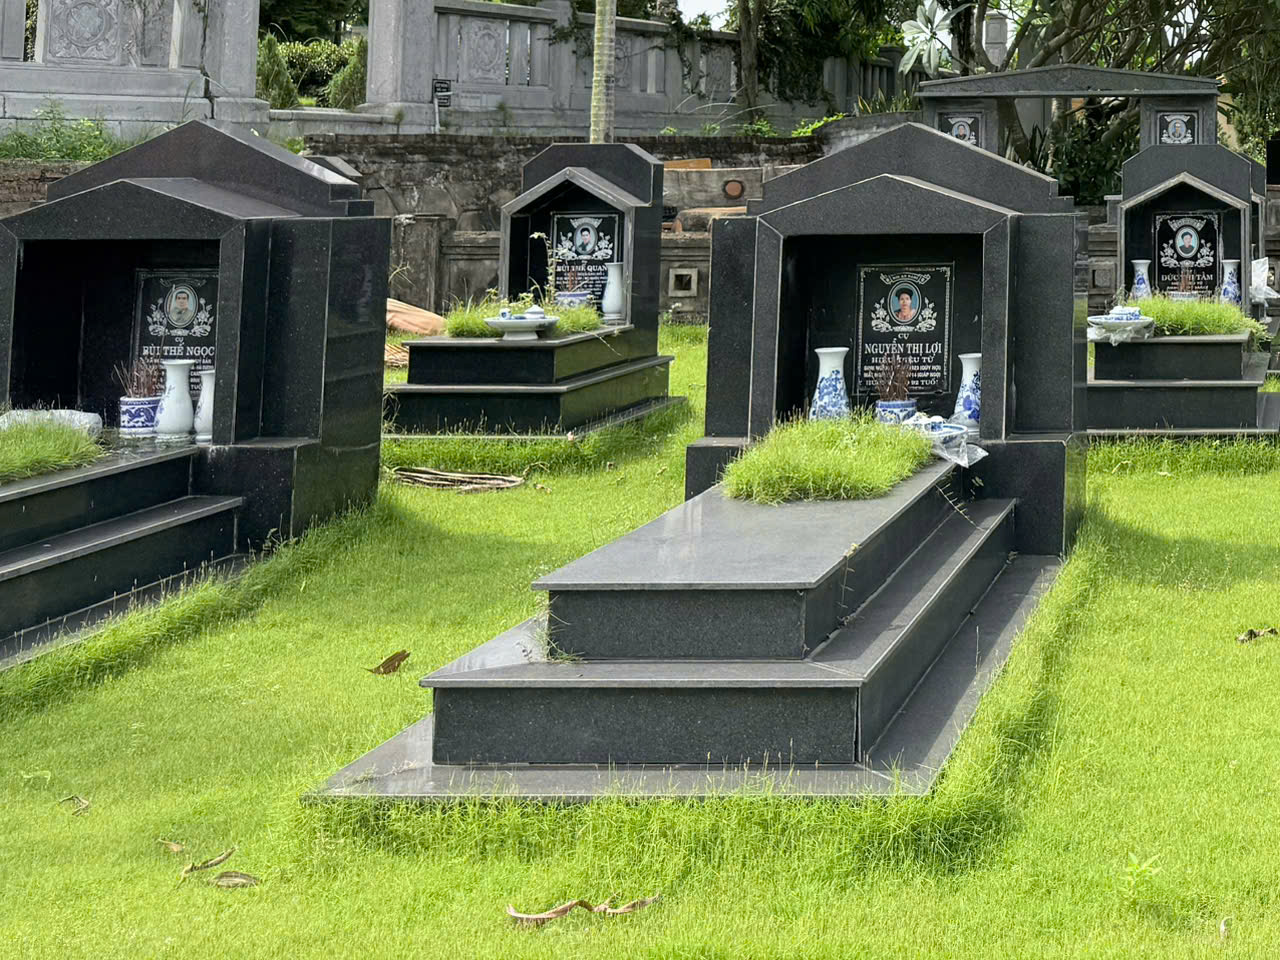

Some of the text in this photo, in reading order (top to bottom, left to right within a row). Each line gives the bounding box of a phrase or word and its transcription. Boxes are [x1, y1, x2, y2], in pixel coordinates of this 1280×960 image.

[186, 345, 216, 358] NGỌC
[906, 343, 924, 356] THỊ
[925, 342, 942, 356] LỢI
